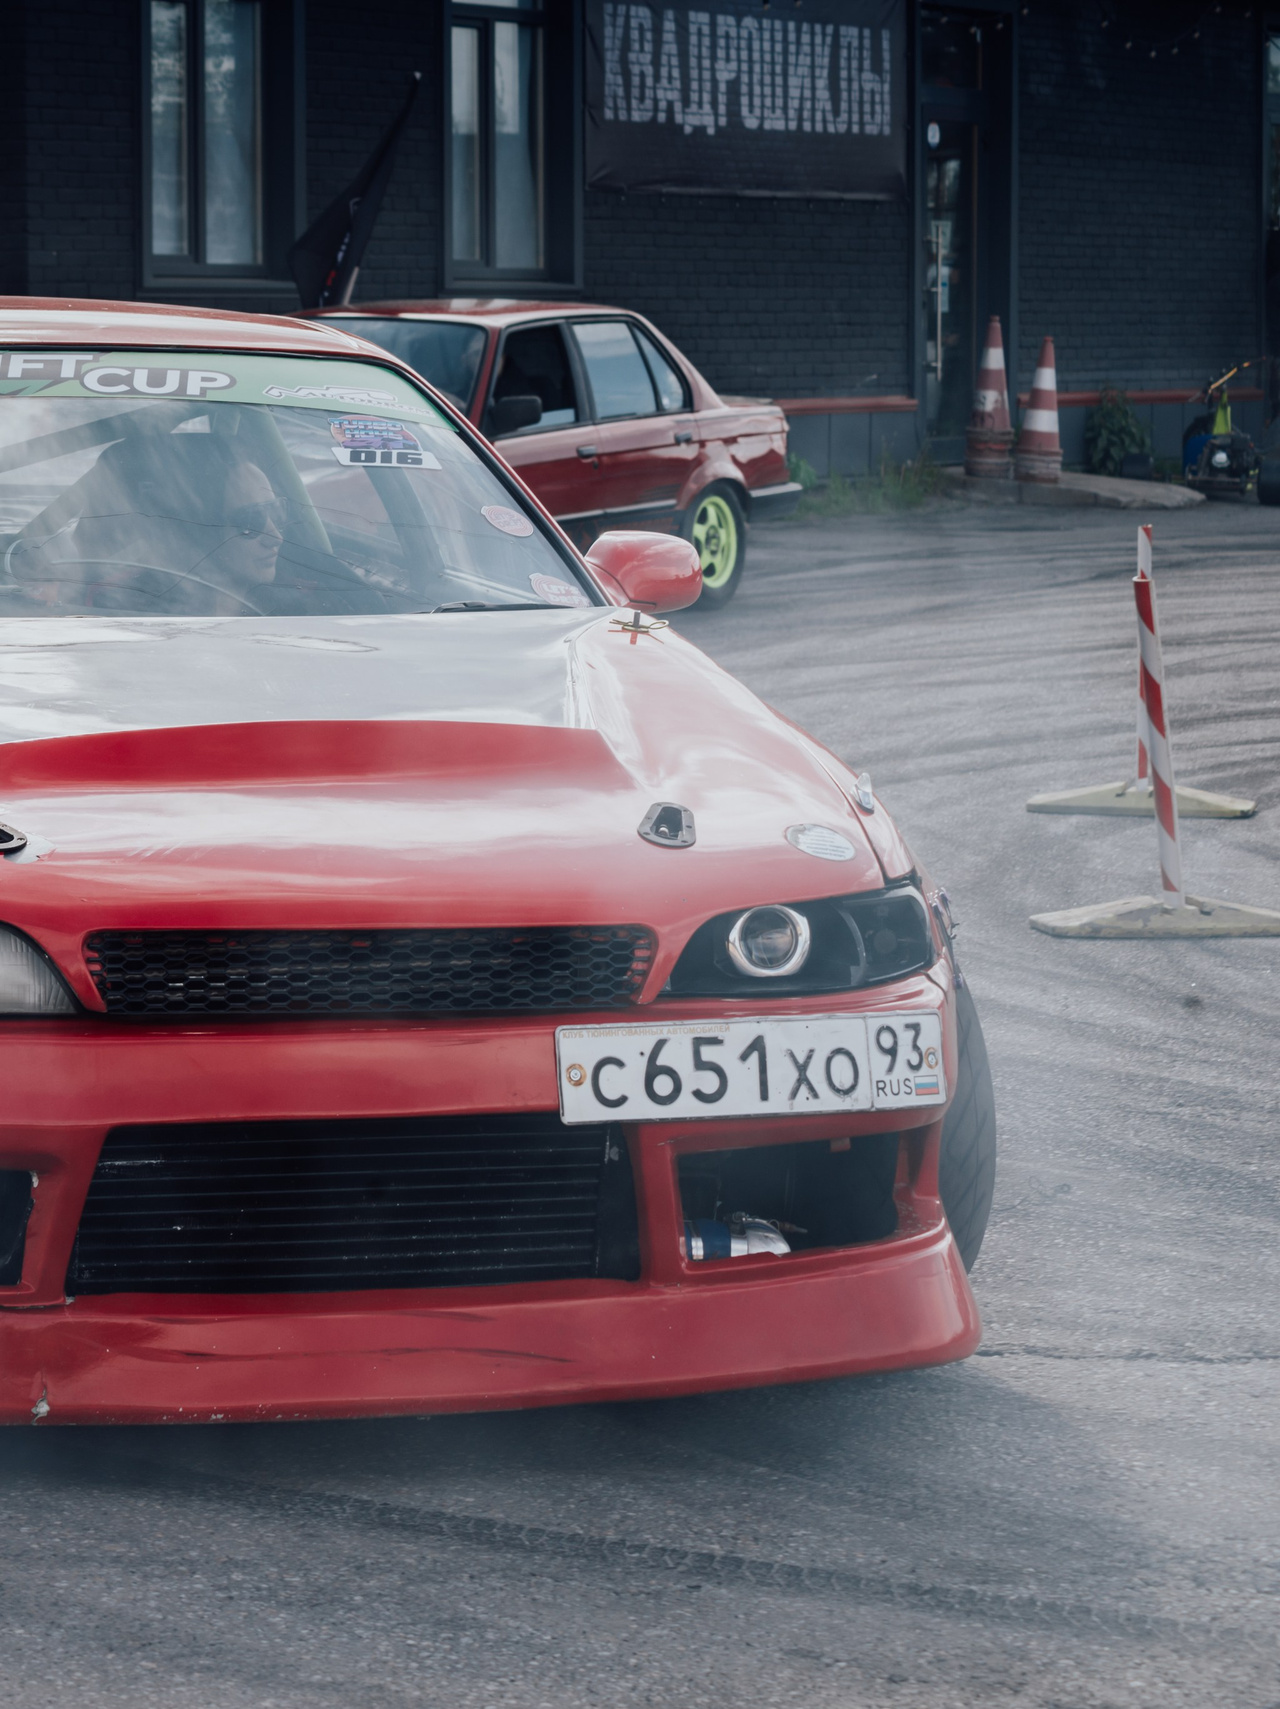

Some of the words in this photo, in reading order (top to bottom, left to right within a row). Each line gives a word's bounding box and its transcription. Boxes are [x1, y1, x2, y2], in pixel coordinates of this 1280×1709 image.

[82, 366, 232, 396] CUP
[349, 449, 423, 466] 016
[562, 1030, 584, 1039] КЛУБ
[666, 1023, 731, 1036] АВТОМОБИЛЕЙ
[875, 1022, 924, 1076] 93
[590, 1034, 860, 1109] С651ХО
[875, 1078, 914, 1098] RUS
